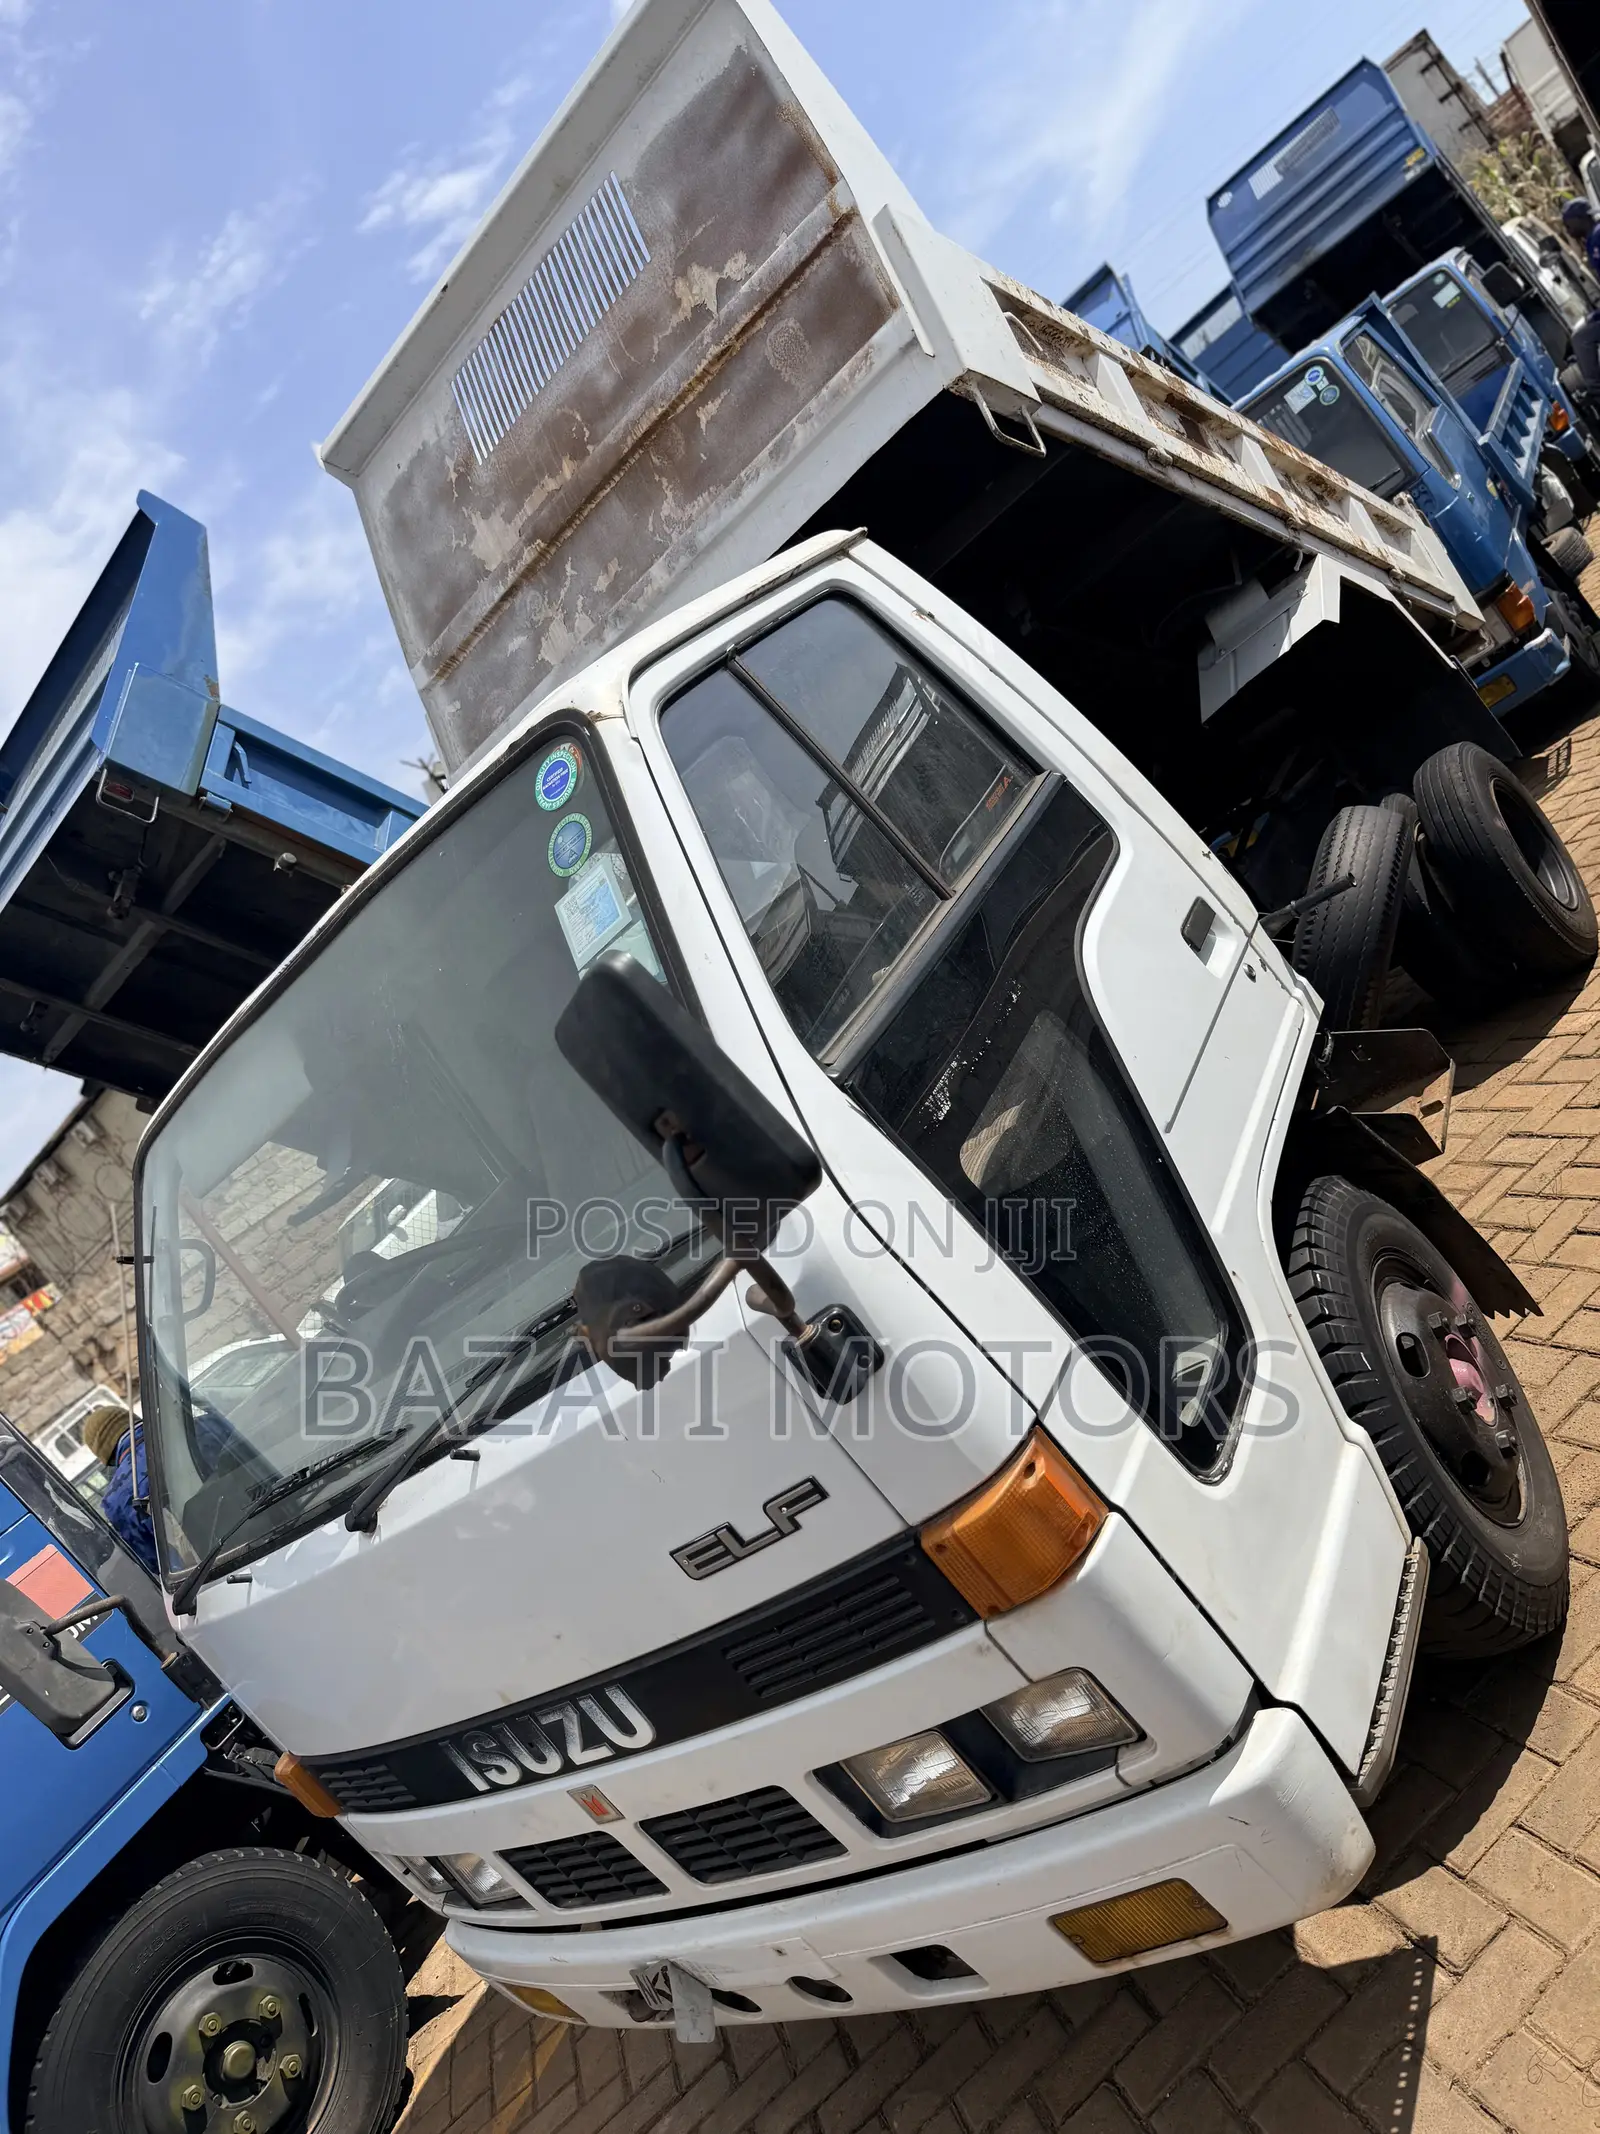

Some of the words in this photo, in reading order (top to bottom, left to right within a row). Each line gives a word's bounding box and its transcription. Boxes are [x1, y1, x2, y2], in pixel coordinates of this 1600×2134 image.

[536, 760, 550, 790] QUALITY
[551, 751, 577, 773] INSPECTION
[669, 1475, 830, 1580] ELF
[438, 1683, 656, 1792] ISUZU
